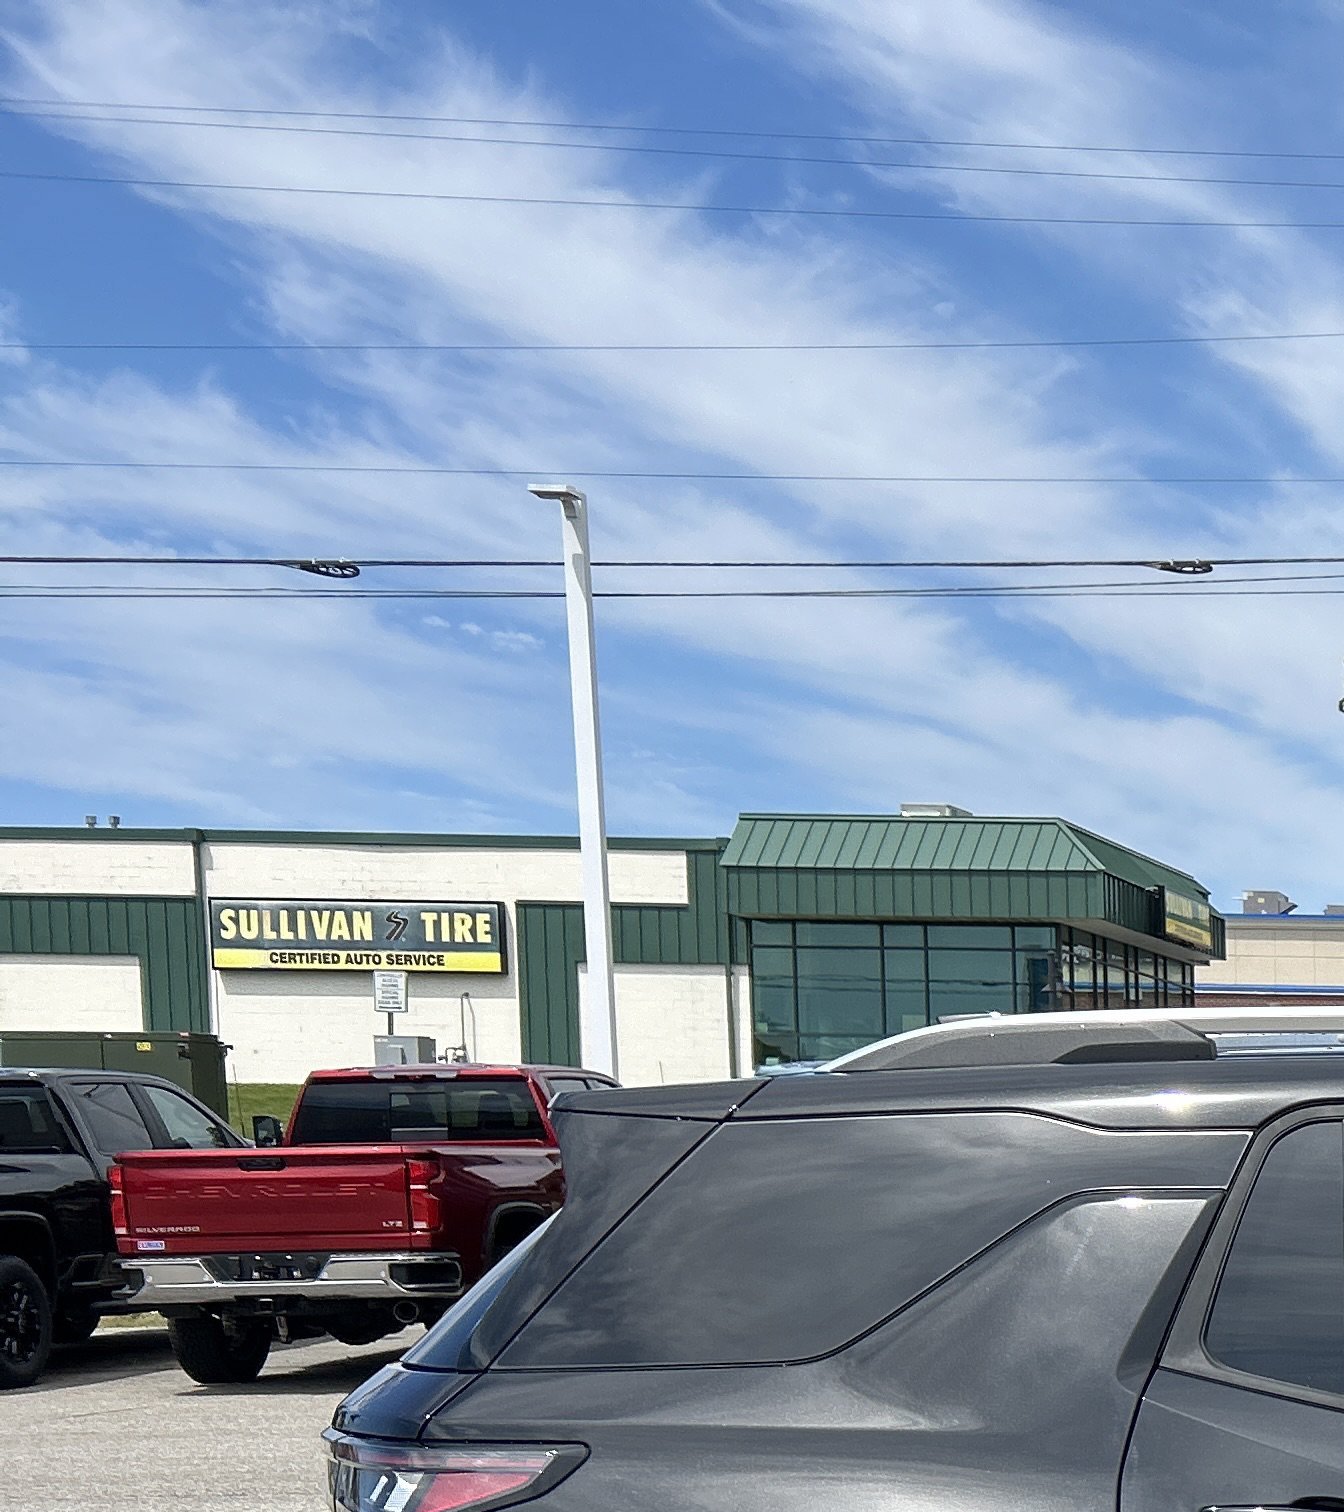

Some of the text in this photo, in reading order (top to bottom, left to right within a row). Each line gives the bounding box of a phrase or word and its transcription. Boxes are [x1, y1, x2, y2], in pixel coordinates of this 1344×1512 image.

[219, 908, 493, 944] SULLIVAN TIRE
[269, 951, 445, 967] CERTIFIED AUTO SERVICE
[144, 1182, 386, 1200] CHEVROLET
[135, 1225, 201, 1234] SILVERADO
